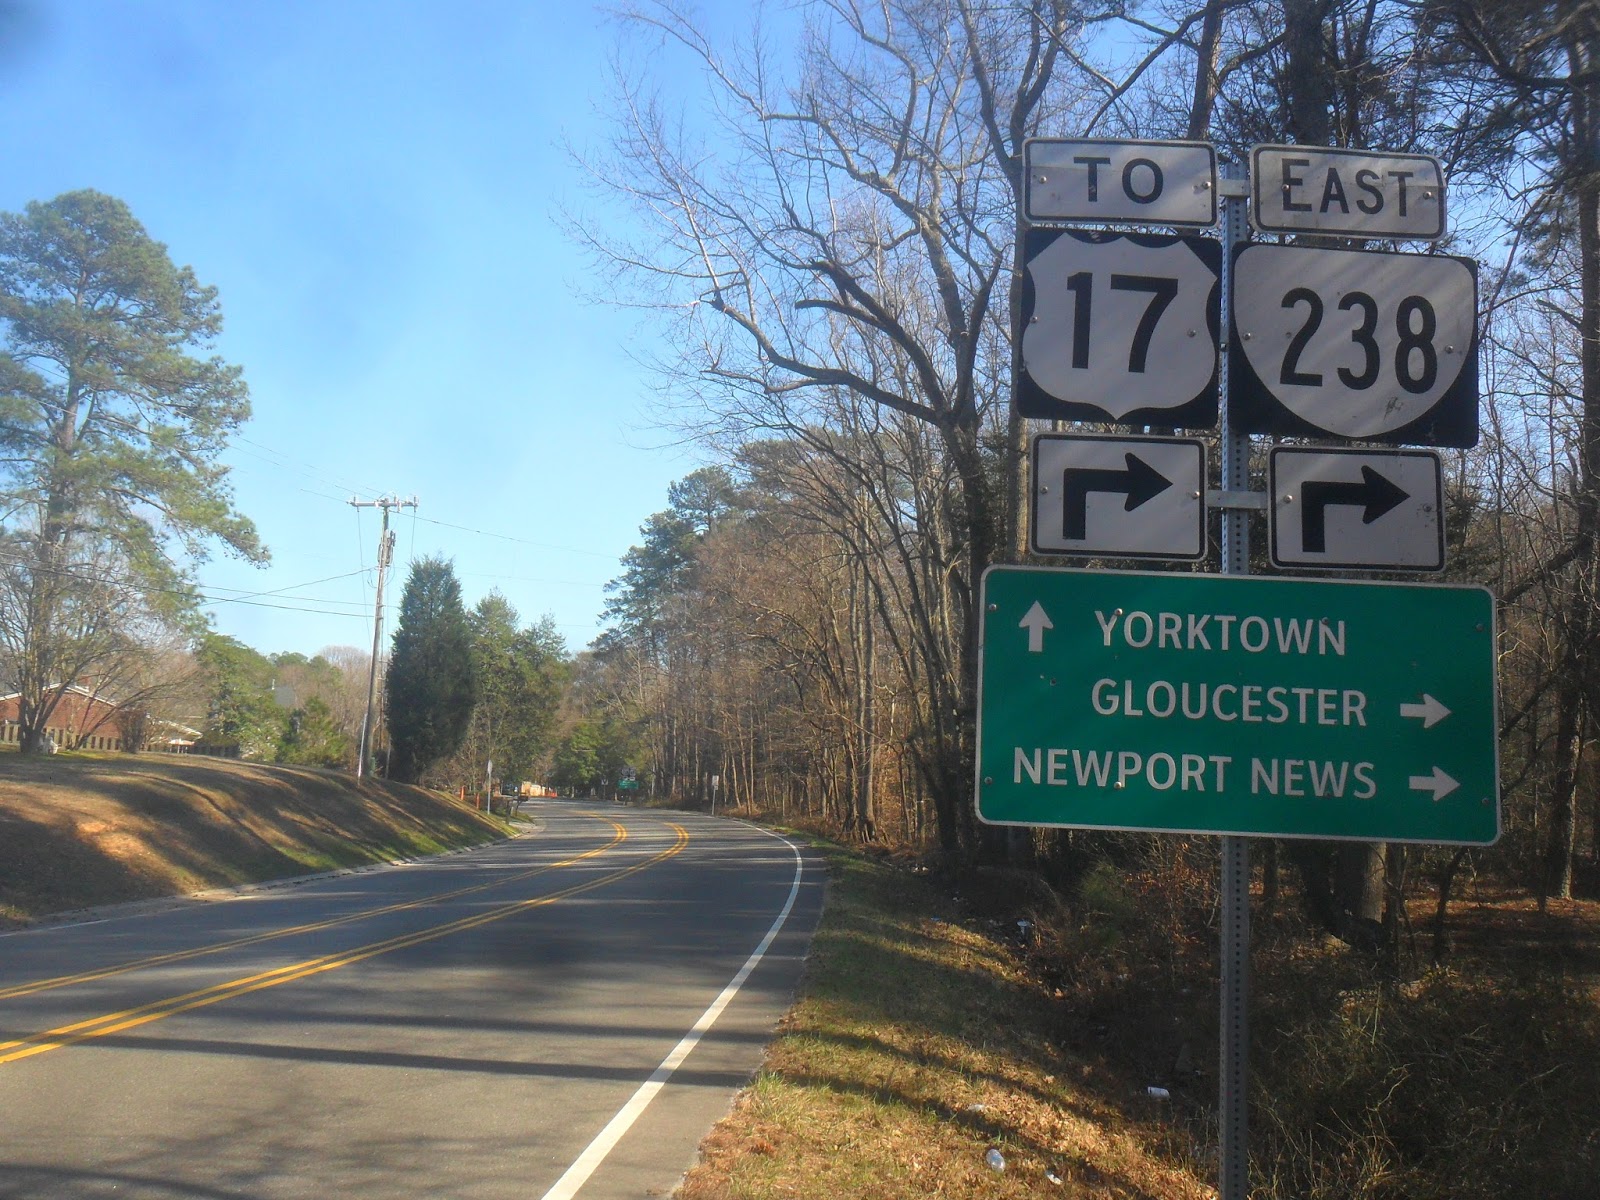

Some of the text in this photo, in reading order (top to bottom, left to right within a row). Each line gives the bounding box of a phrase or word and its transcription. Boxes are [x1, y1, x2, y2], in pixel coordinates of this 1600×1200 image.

[1073, 157, 1163, 204] TO
[1282, 158, 1414, 217] EAST
[1067, 272, 1179, 374] 17
[1279, 287, 1438, 394] 238
[1094, 610, 1346, 656] YORKTOWN
[1091, 678, 1367, 727] GLOUCESTER
[1013, 746, 1377, 799] NEWPORT NEWS
